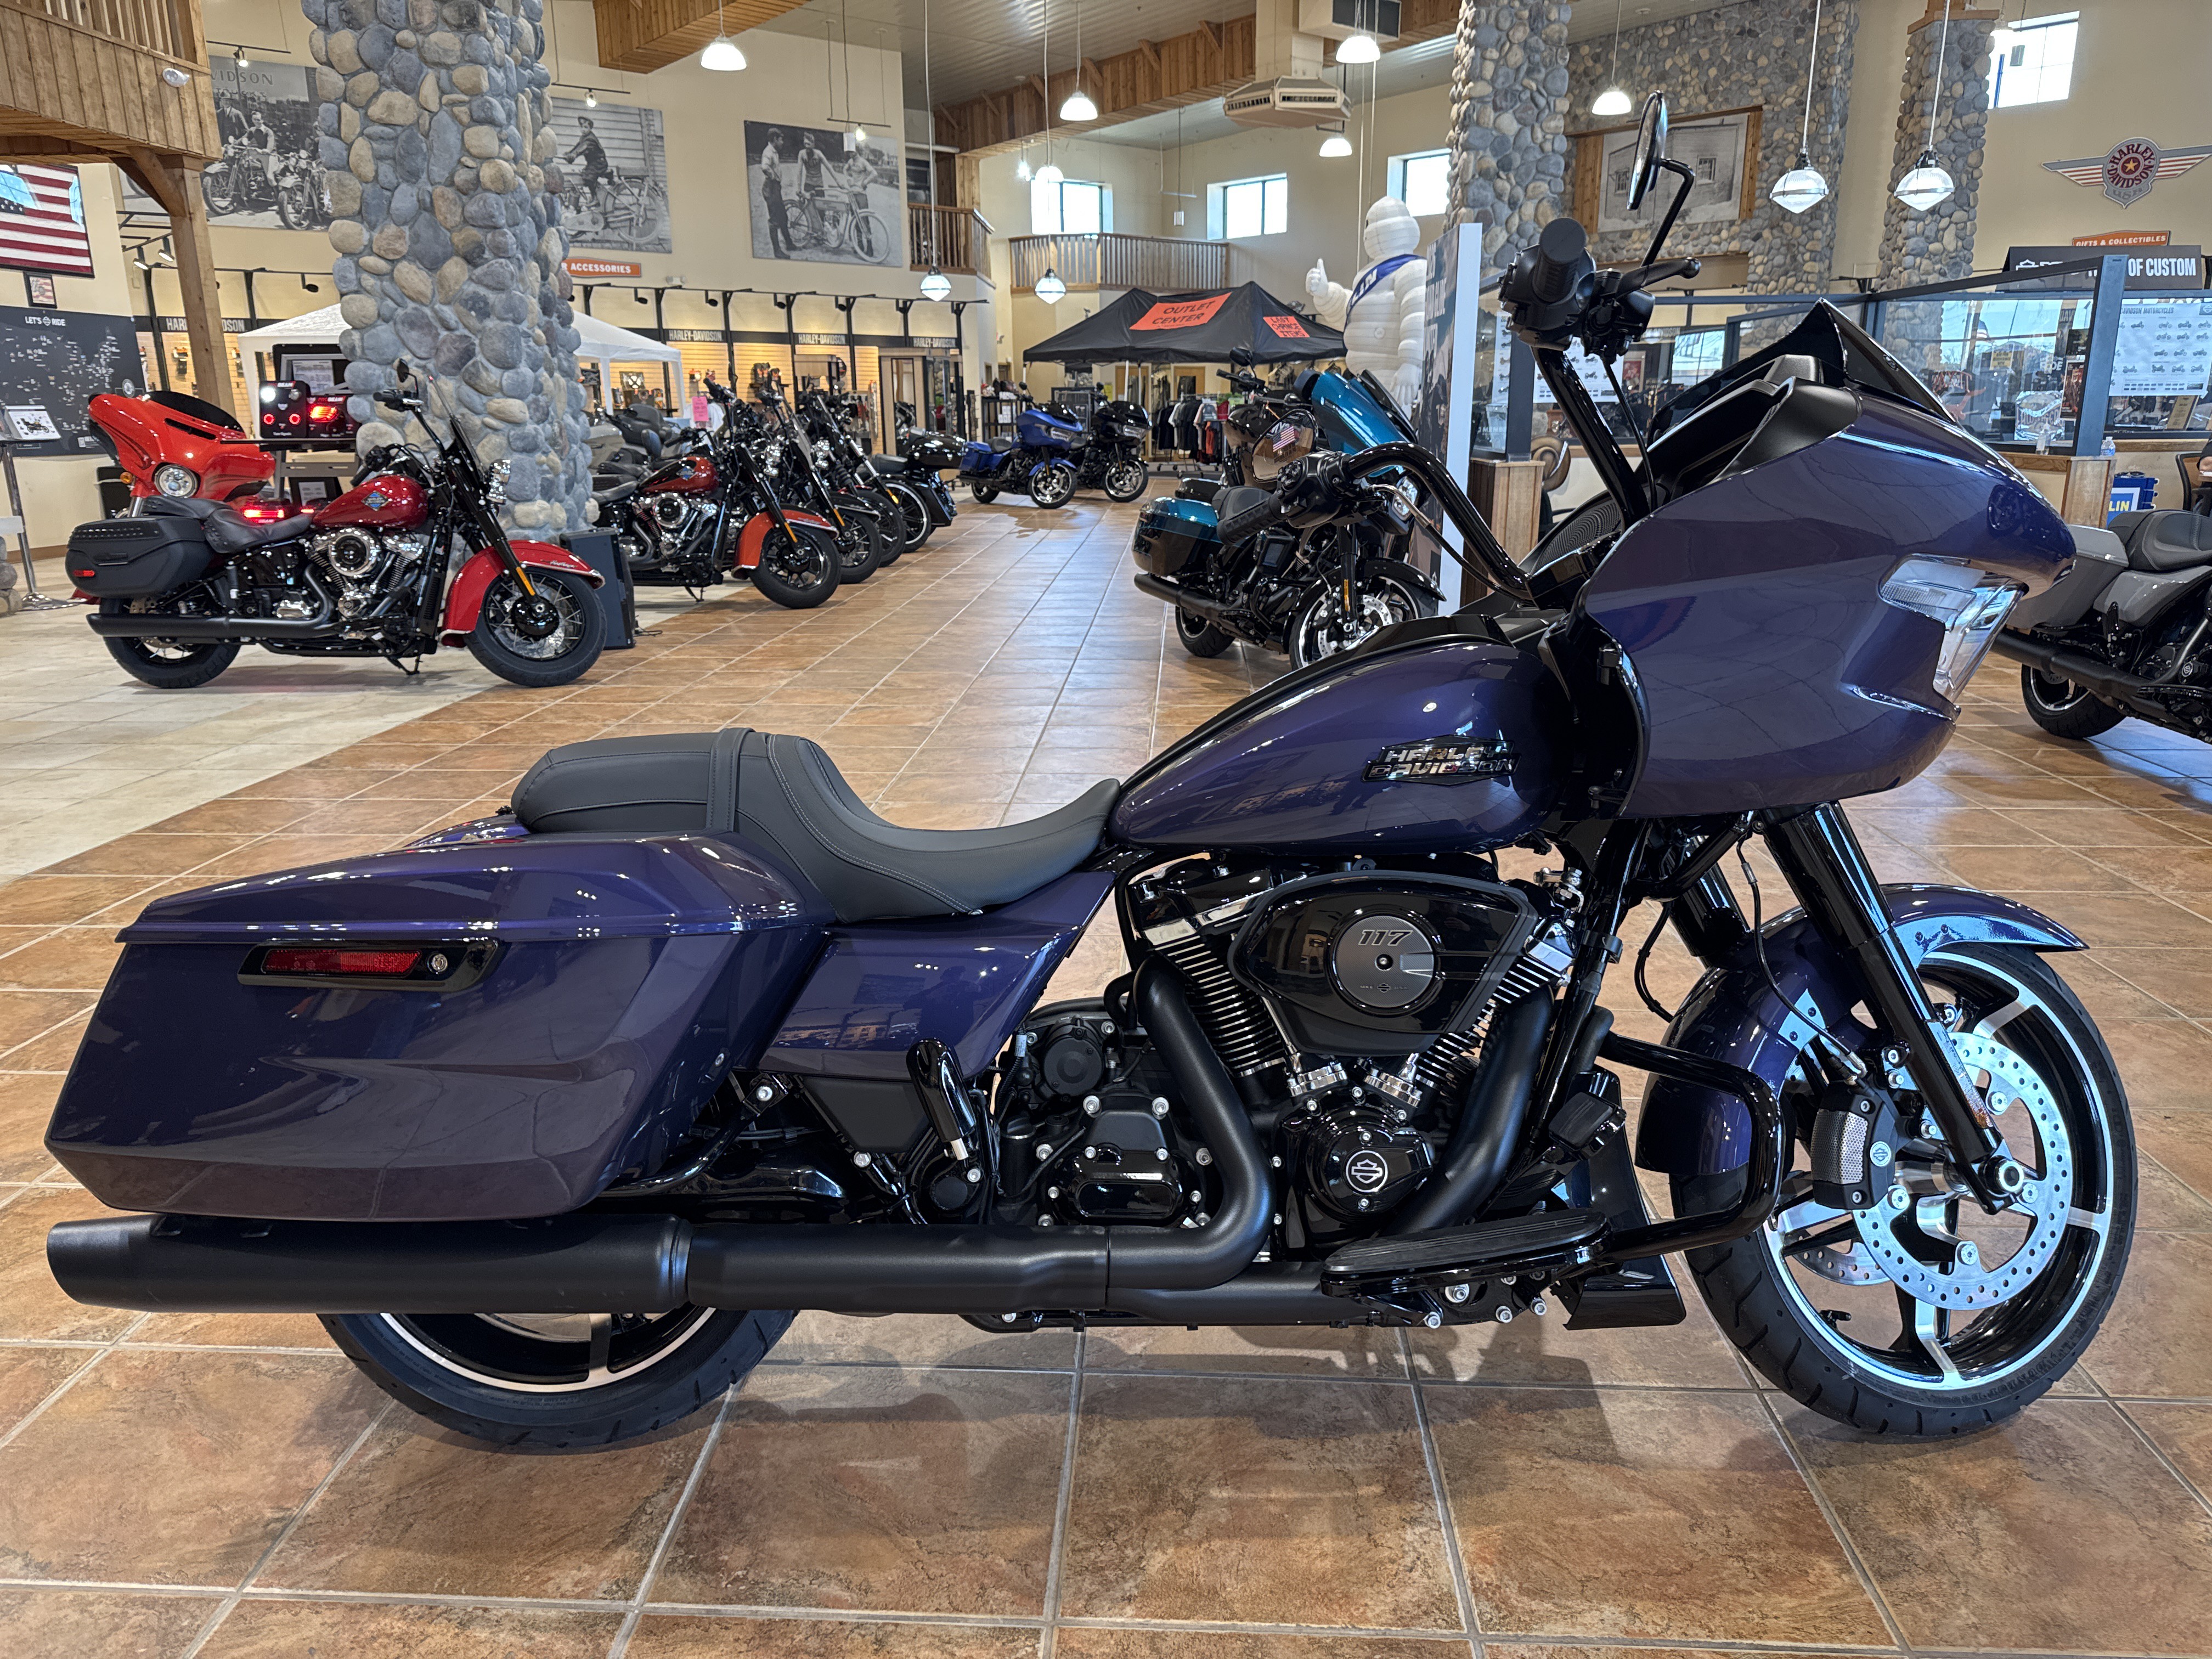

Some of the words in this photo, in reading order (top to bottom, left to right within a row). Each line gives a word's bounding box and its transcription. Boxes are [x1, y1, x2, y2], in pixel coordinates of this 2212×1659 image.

[2109, 143, 2155, 166] HARLEY
[2107, 164, 2154, 188] DAVIDSON
[2076, 238, 2097, 246] GIFTS
[2108, 235, 2166, 246] COLLECTIBLES
[571, 262, 631, 274] ACCESSORIES
[2128, 259, 2143, 276] OF
[2146, 258, 2196, 276] CUSTOM
[1163, 300, 1216, 314] OUTLET
[25, 316, 42, 325] LET'S
[52, 318, 65, 326] RIDE
[1152, 313, 1205, 325] CENTER
[669, 330, 723, 342] HARLEY-DAVIDSON
[798, 334, 845, 345] HARLEY-DAVIDSON
[1368, 758, 1516, 777] DAVIDSON
[1358, 929, 1413, 946] 117
